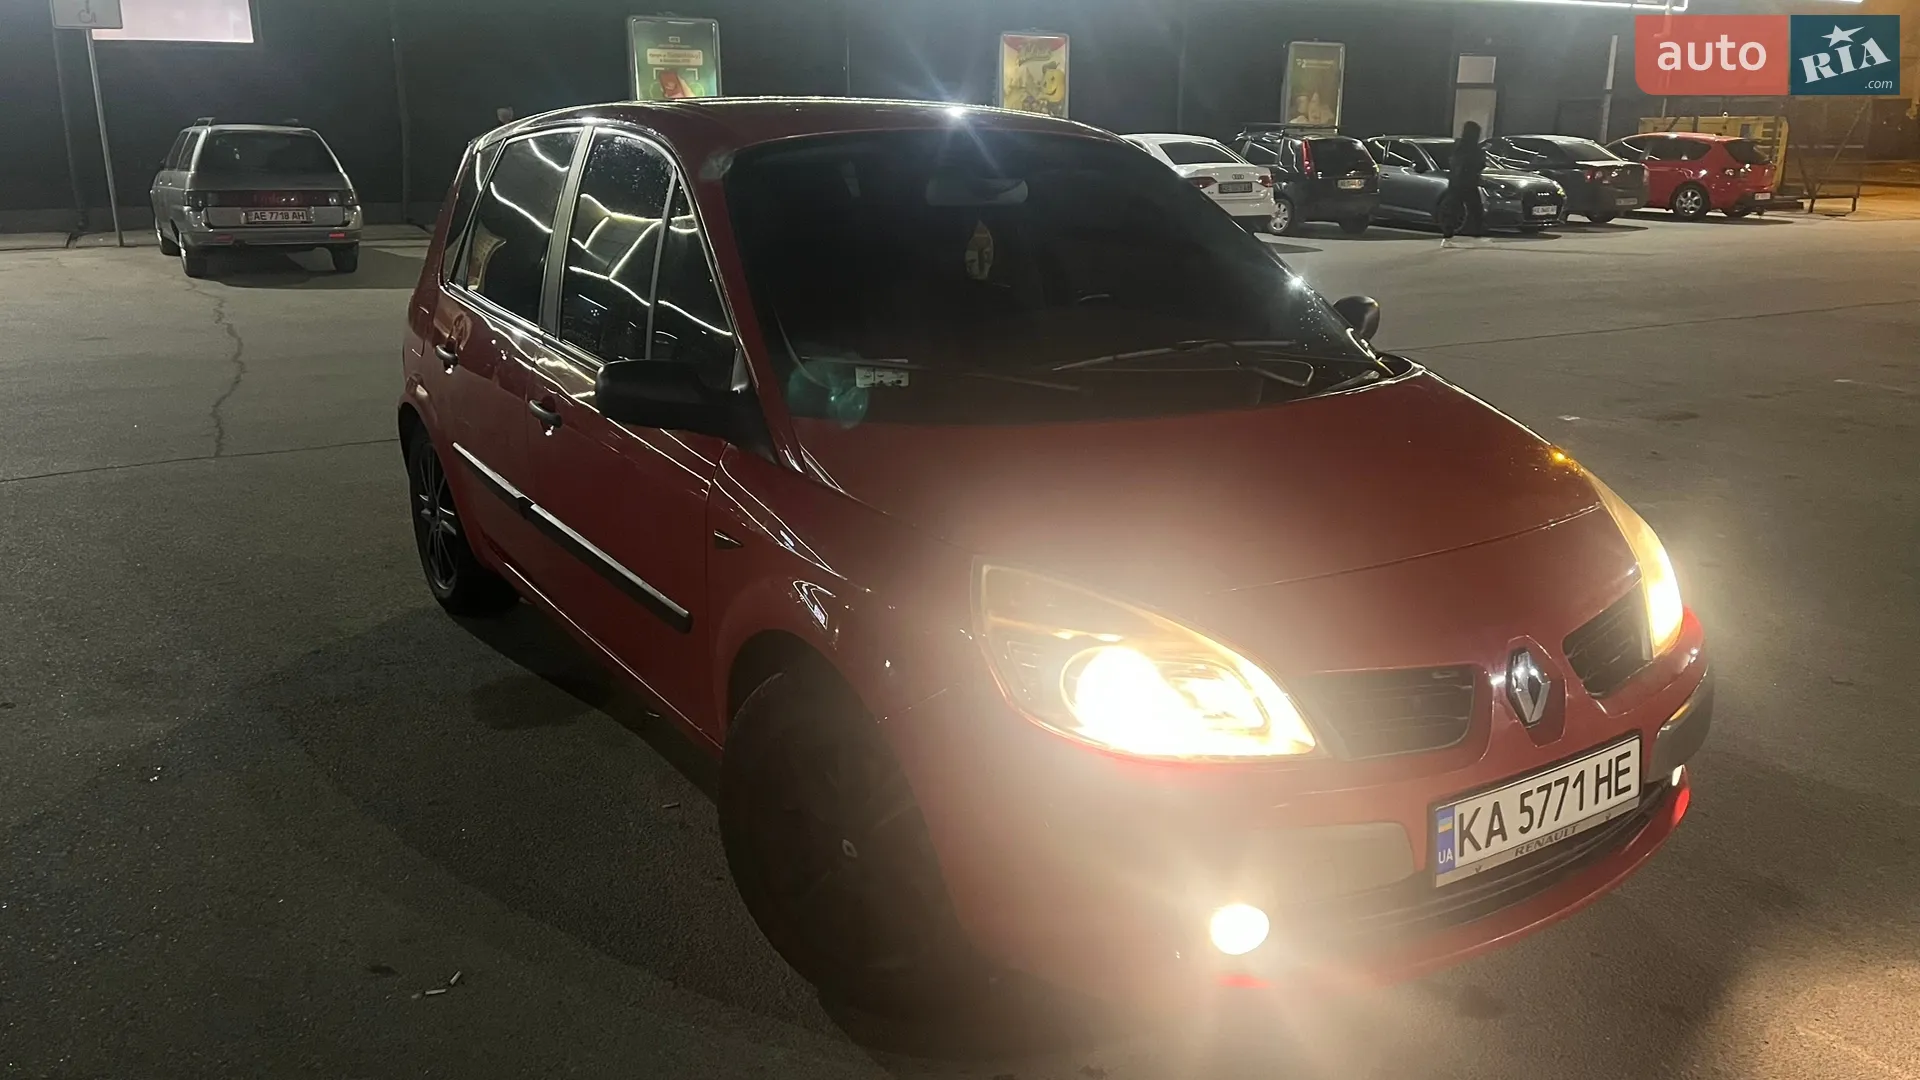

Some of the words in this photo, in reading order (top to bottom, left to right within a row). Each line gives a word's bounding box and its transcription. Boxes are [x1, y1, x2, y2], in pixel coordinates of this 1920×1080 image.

[253, 212, 267, 221] AE
[291, 210, 305, 220] AH
[1458, 801, 1508, 858] KA
[1518, 770, 1585, 835] 5771
[1594, 750, 1632, 806] HE
[1514, 824, 1579, 857] RENAULT
[1438, 848, 1453, 864] UA
